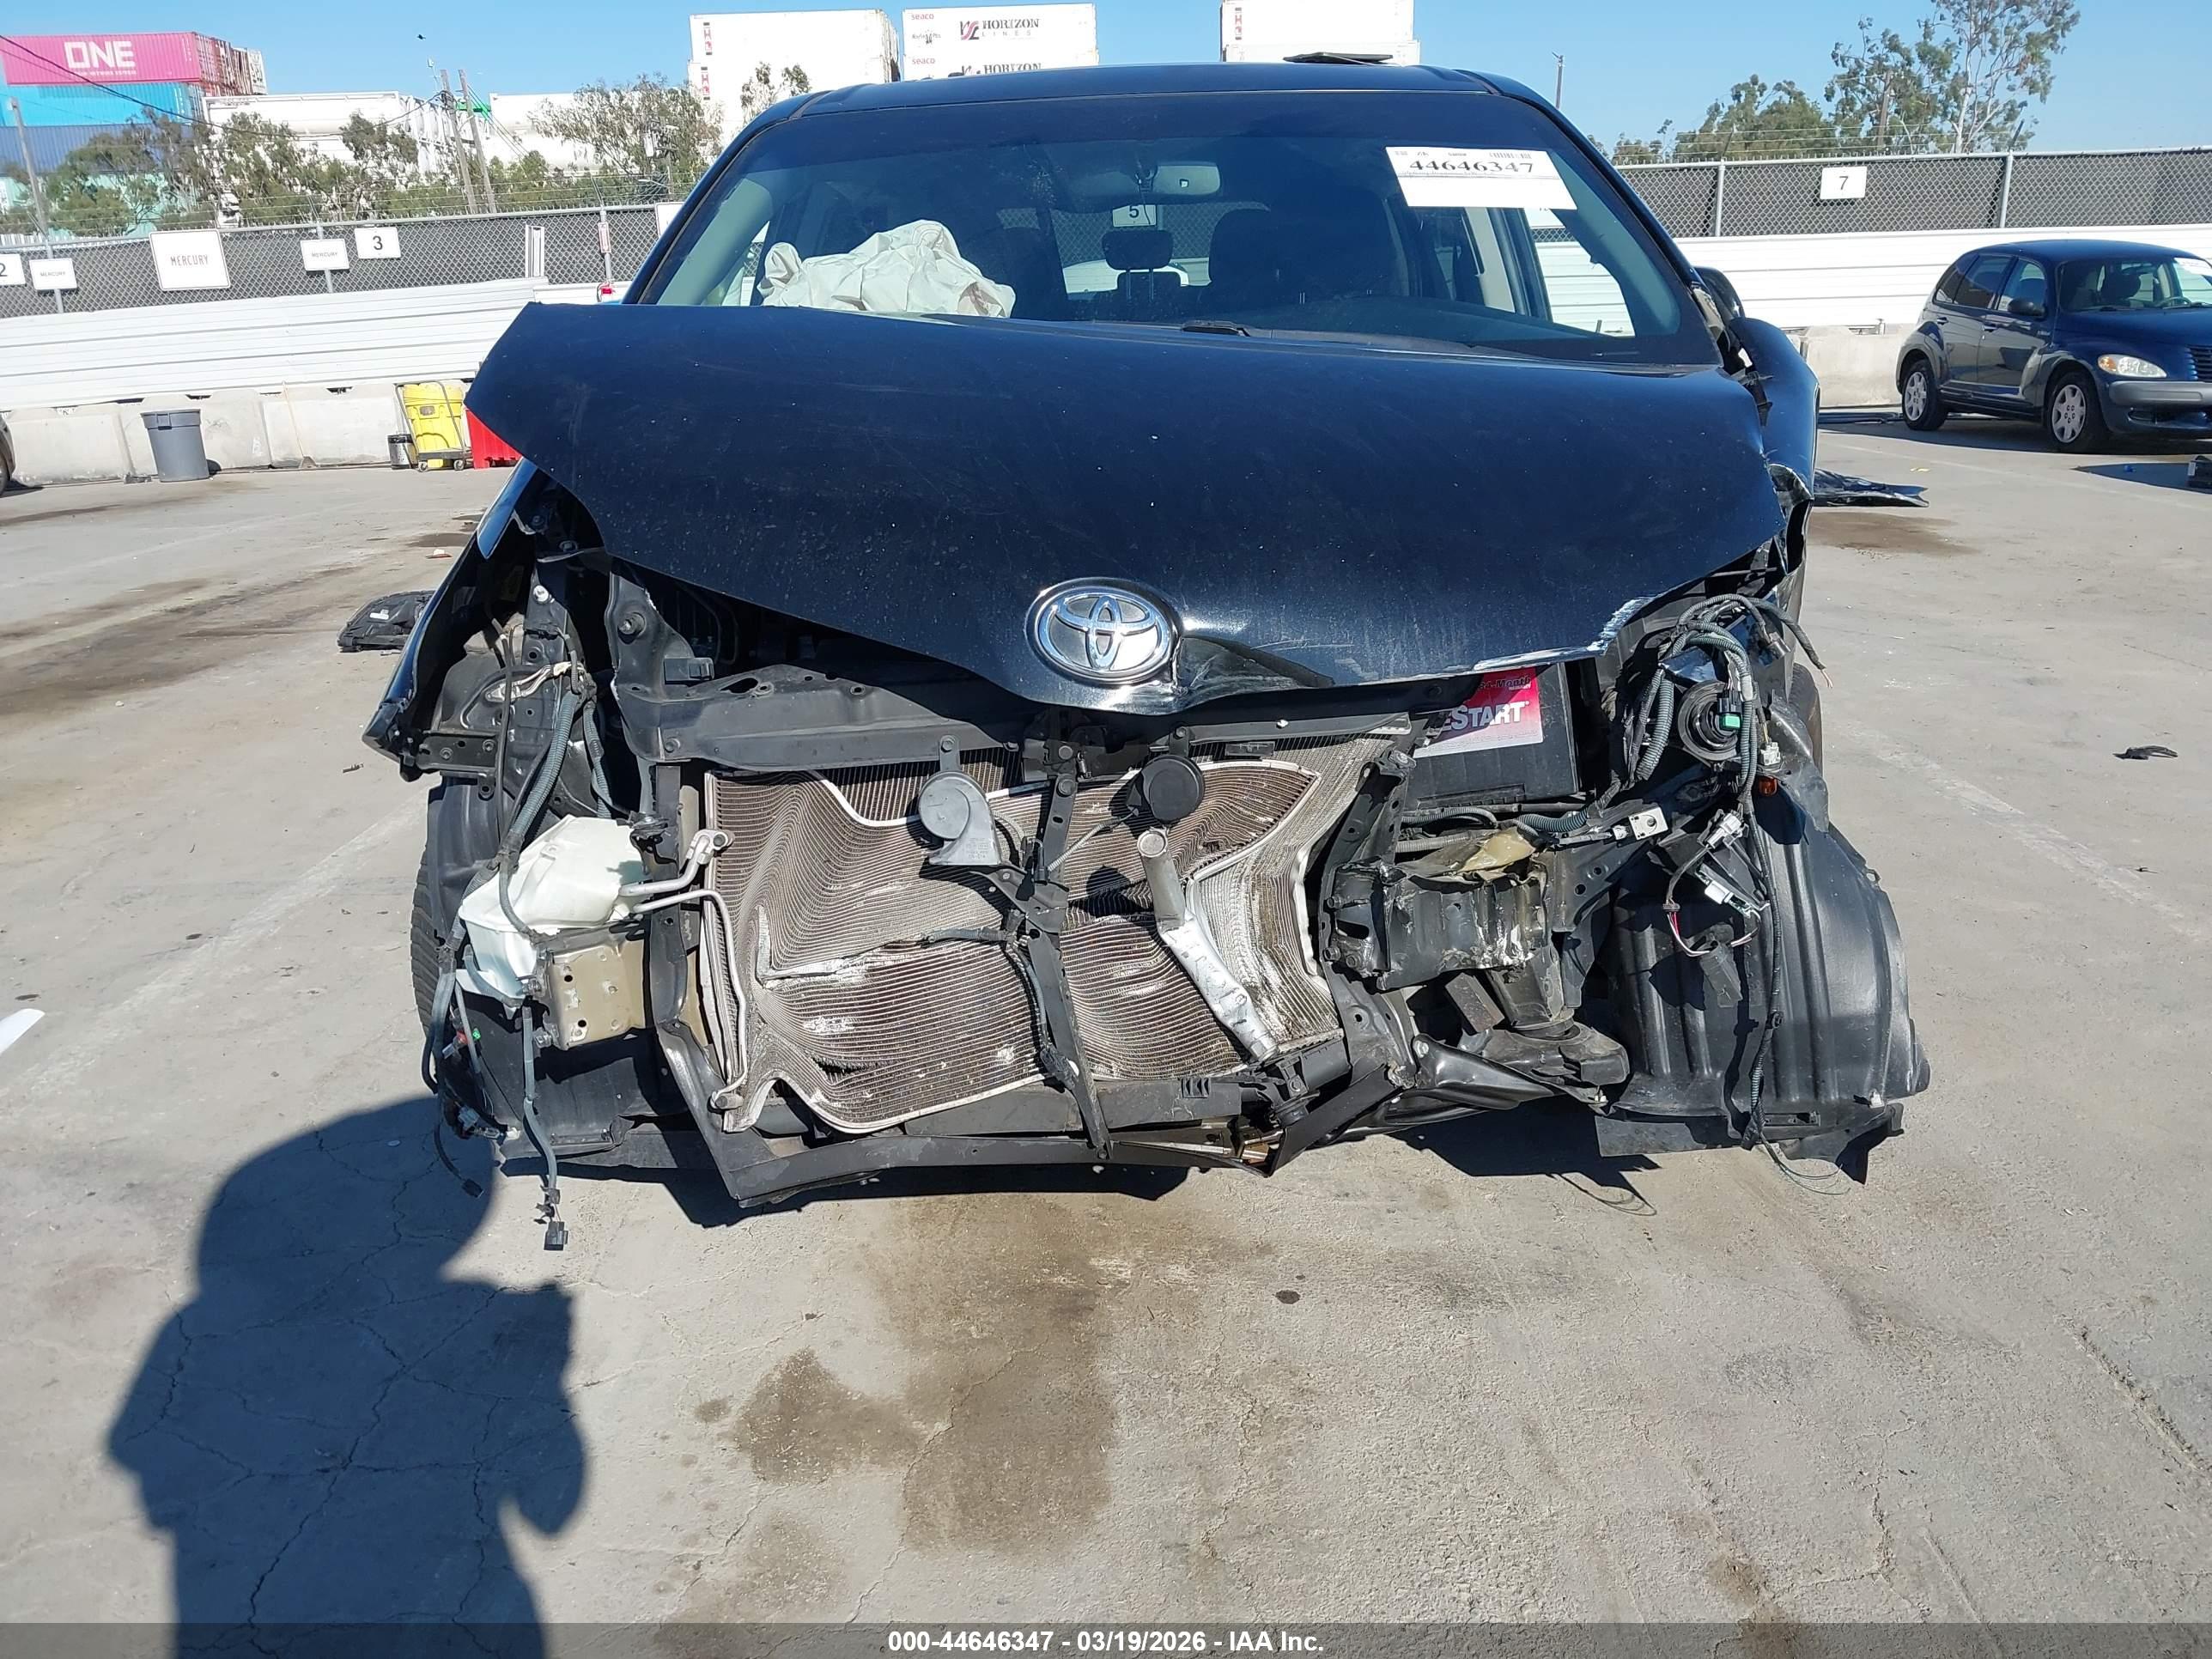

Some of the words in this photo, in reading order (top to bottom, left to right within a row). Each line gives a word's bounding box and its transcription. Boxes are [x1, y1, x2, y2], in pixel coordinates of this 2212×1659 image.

[981, 18, 1041, 29] HORIZON
[64, 41, 136, 69] ONE
[1410, 160, 1534, 173] 44646347
[1839, 175, 1849, 190] 7
[1128, 205, 1139, 218] 5
[373, 235, 383, 250] 3
[170, 254, 209, 266] MERCURY
[0, 263, 8, 277] 2
